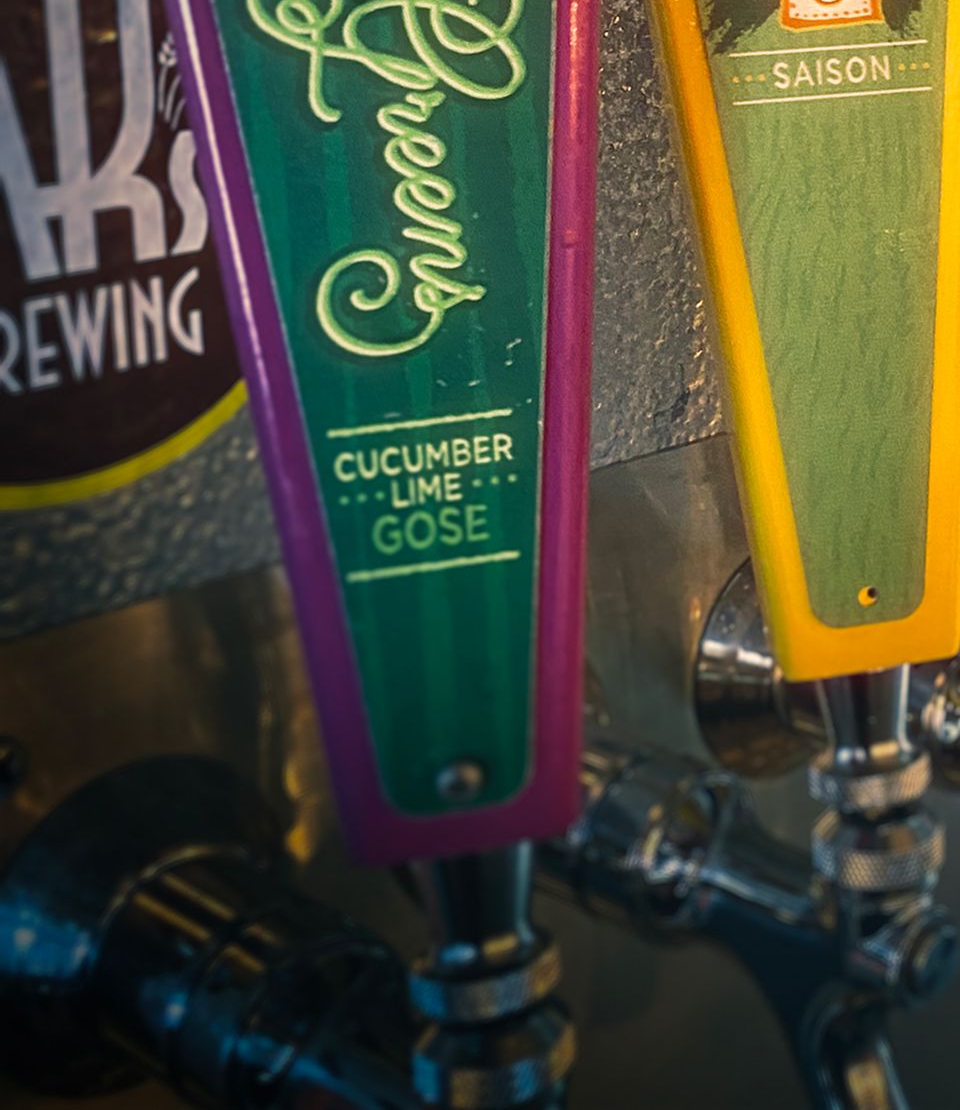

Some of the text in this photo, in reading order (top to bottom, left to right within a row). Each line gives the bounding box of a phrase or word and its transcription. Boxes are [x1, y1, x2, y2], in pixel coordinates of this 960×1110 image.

[771, 56, 891, 91] SAISON
[0, 266, 204, 395] REWING
[334, 433, 514, 482] CUCUMBER
[391, 472, 463, 509] LIME
[372, 504, 490, 555] GOSE
